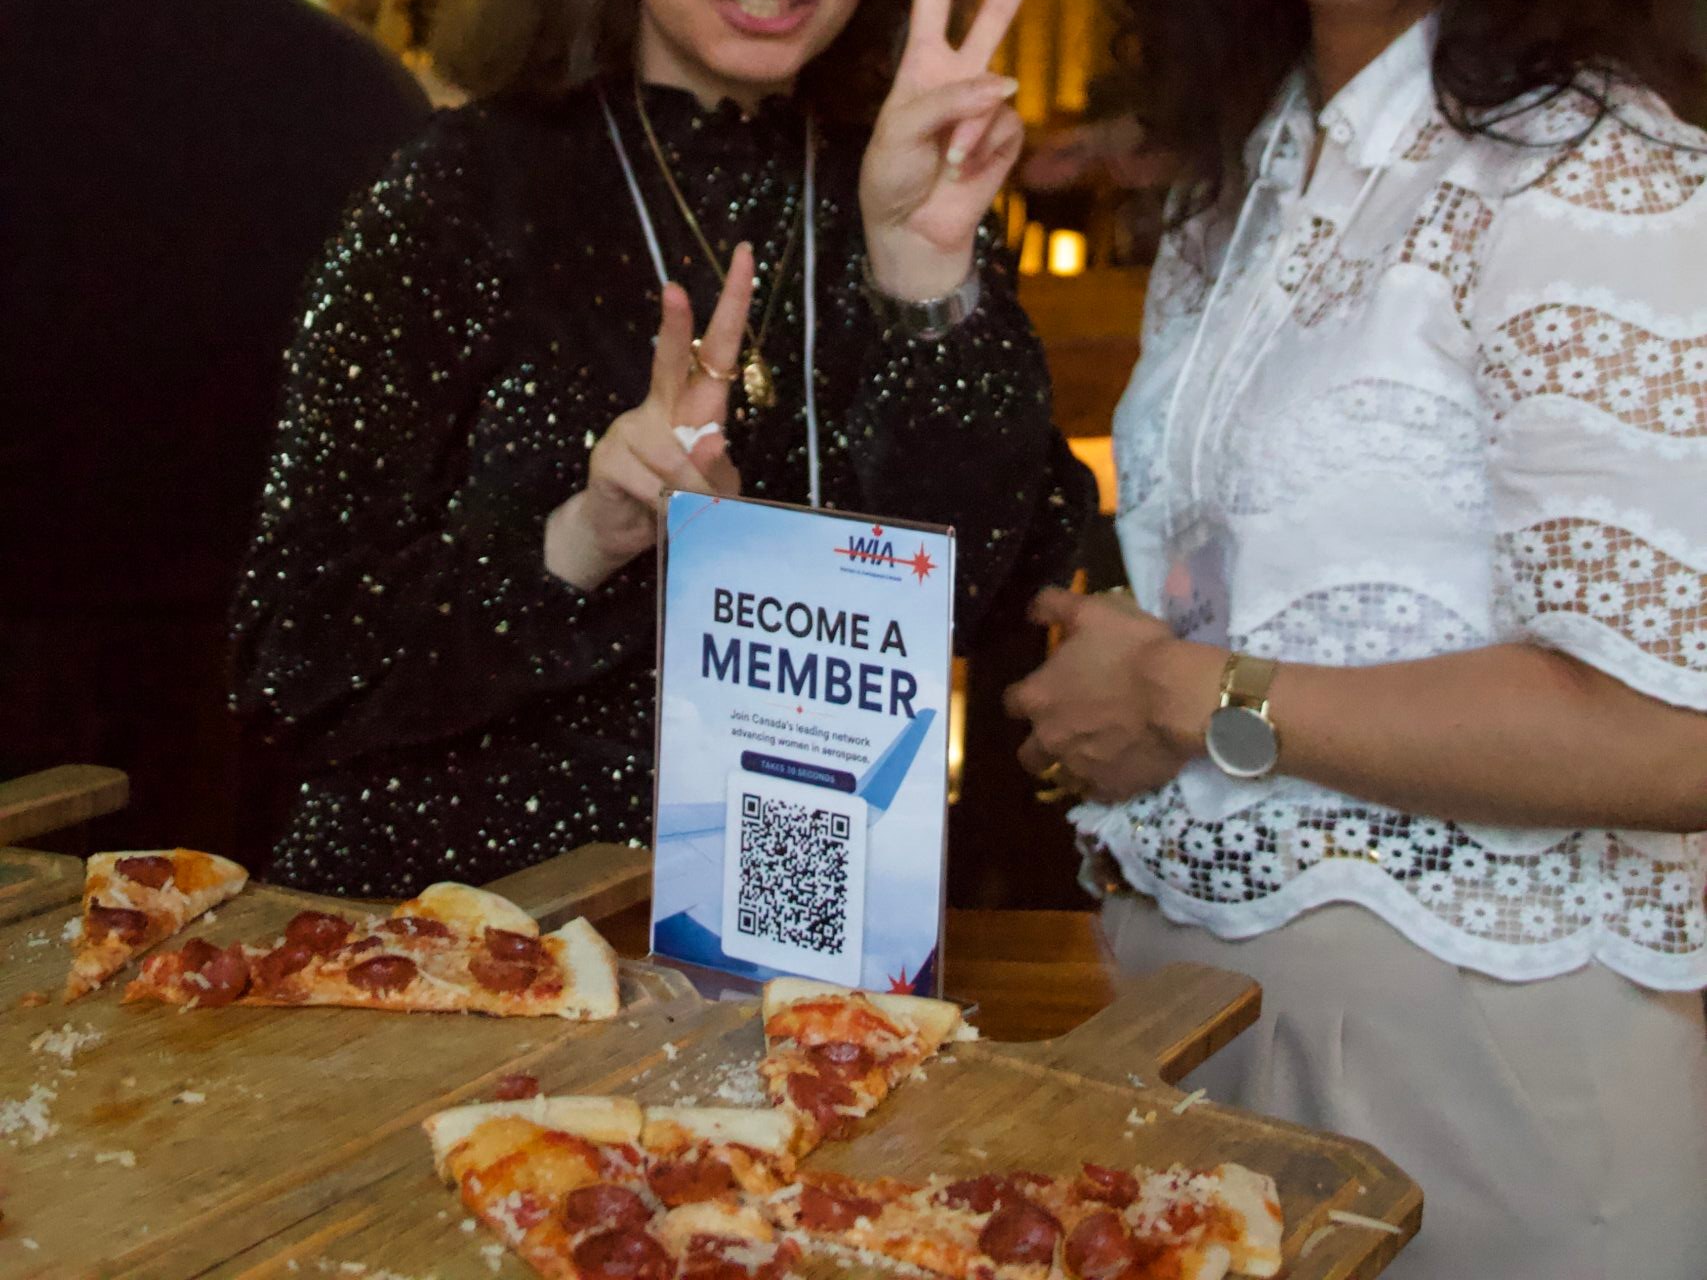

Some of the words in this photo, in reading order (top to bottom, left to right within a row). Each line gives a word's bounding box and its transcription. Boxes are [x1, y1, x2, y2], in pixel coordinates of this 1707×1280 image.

[849, 535, 895, 568] WIA
[713, 587, 870, 651] BECOME
[879, 619, 908, 658] A
[701, 632, 918, 720] MEMBER
[730, 709, 750, 722] Join
[752, 713, 793, 732] Canada's
[796, 722, 830, 741] leading
[832, 732, 871, 747] network
[731, 727, 776, 746] advancing
[778, 738, 810, 751] women
[811, 740, 820, 753] in
[822, 747, 870, 764] aerospace.
[760, 759, 786, 774] TAKES
[797, 767, 836, 784] SECONDS
